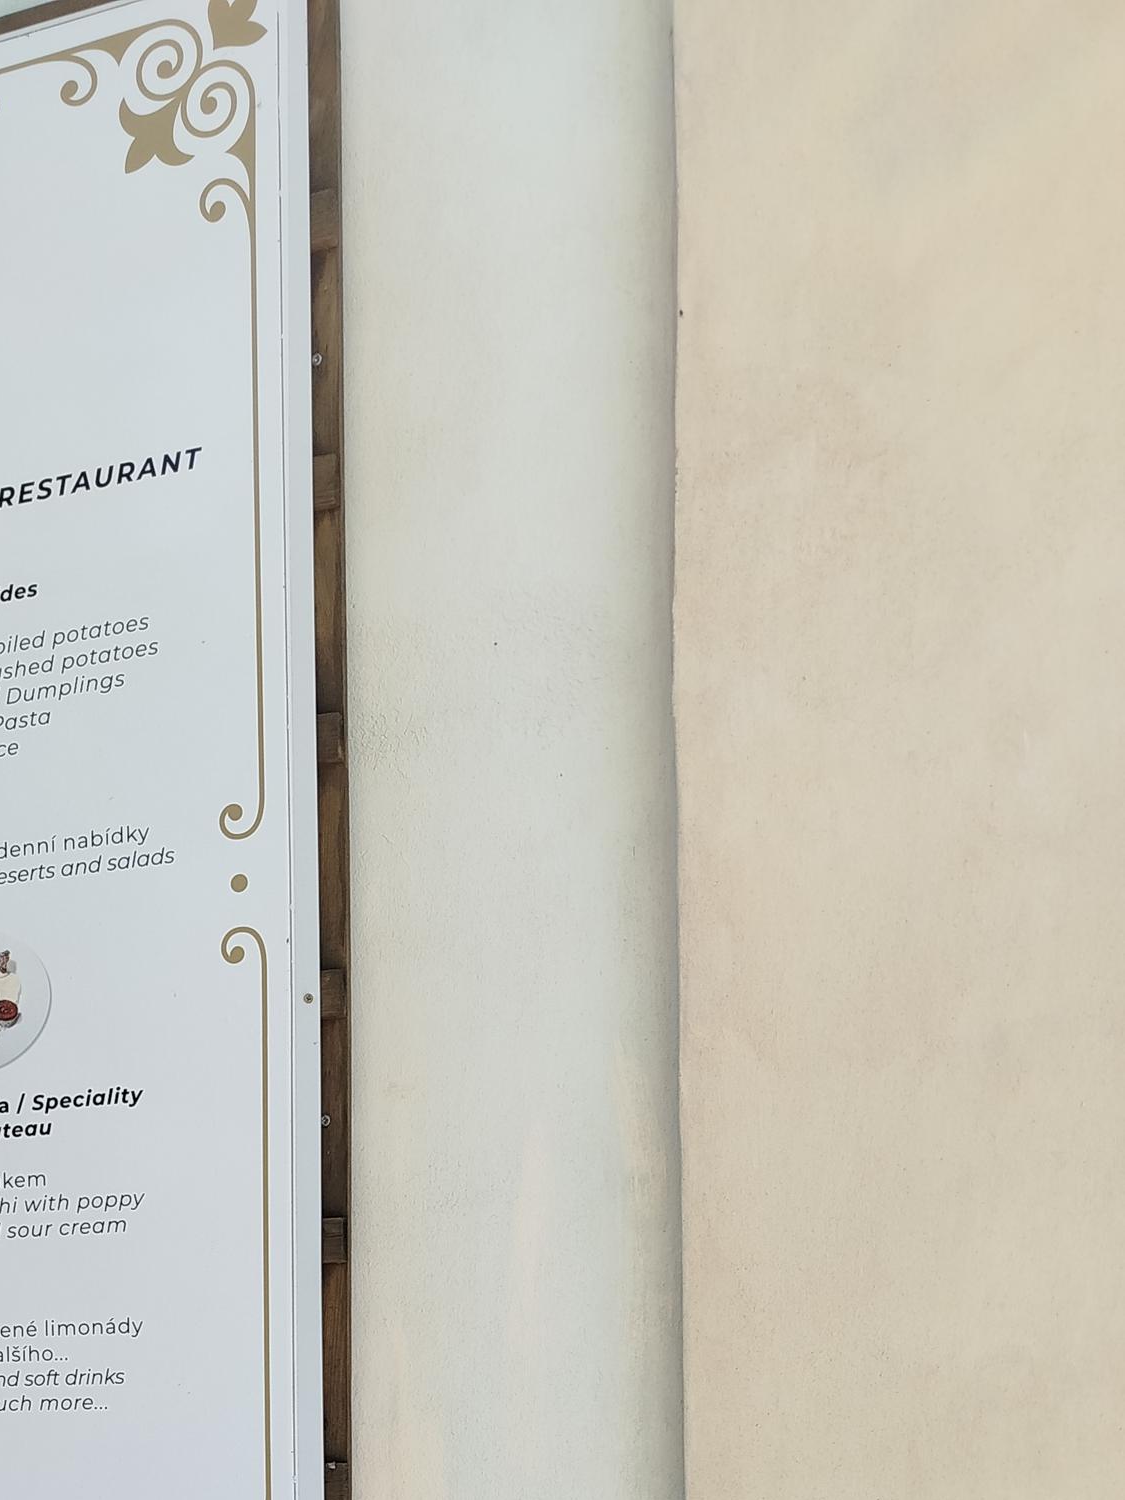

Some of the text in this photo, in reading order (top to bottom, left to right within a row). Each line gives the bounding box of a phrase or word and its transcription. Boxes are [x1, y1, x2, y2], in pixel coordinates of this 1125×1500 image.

[51, 616, 150, 651] potatoes
[60, 641, 159, 675] potatoes
[6, 673, 125, 705] Dumplings
[31, 1086, 144, 1115] Speciality
[24, 1193, 70, 1213] with
[76, 1193, 146, 1214] poppy
[6, 1223, 54, 1239] sour
[58, 1219, 127, 1236] cream
[45, 1316, 144, 1338] limonády
[23, 1369, 60, 1387] soft
[64, 1367, 125, 1386] drinks
